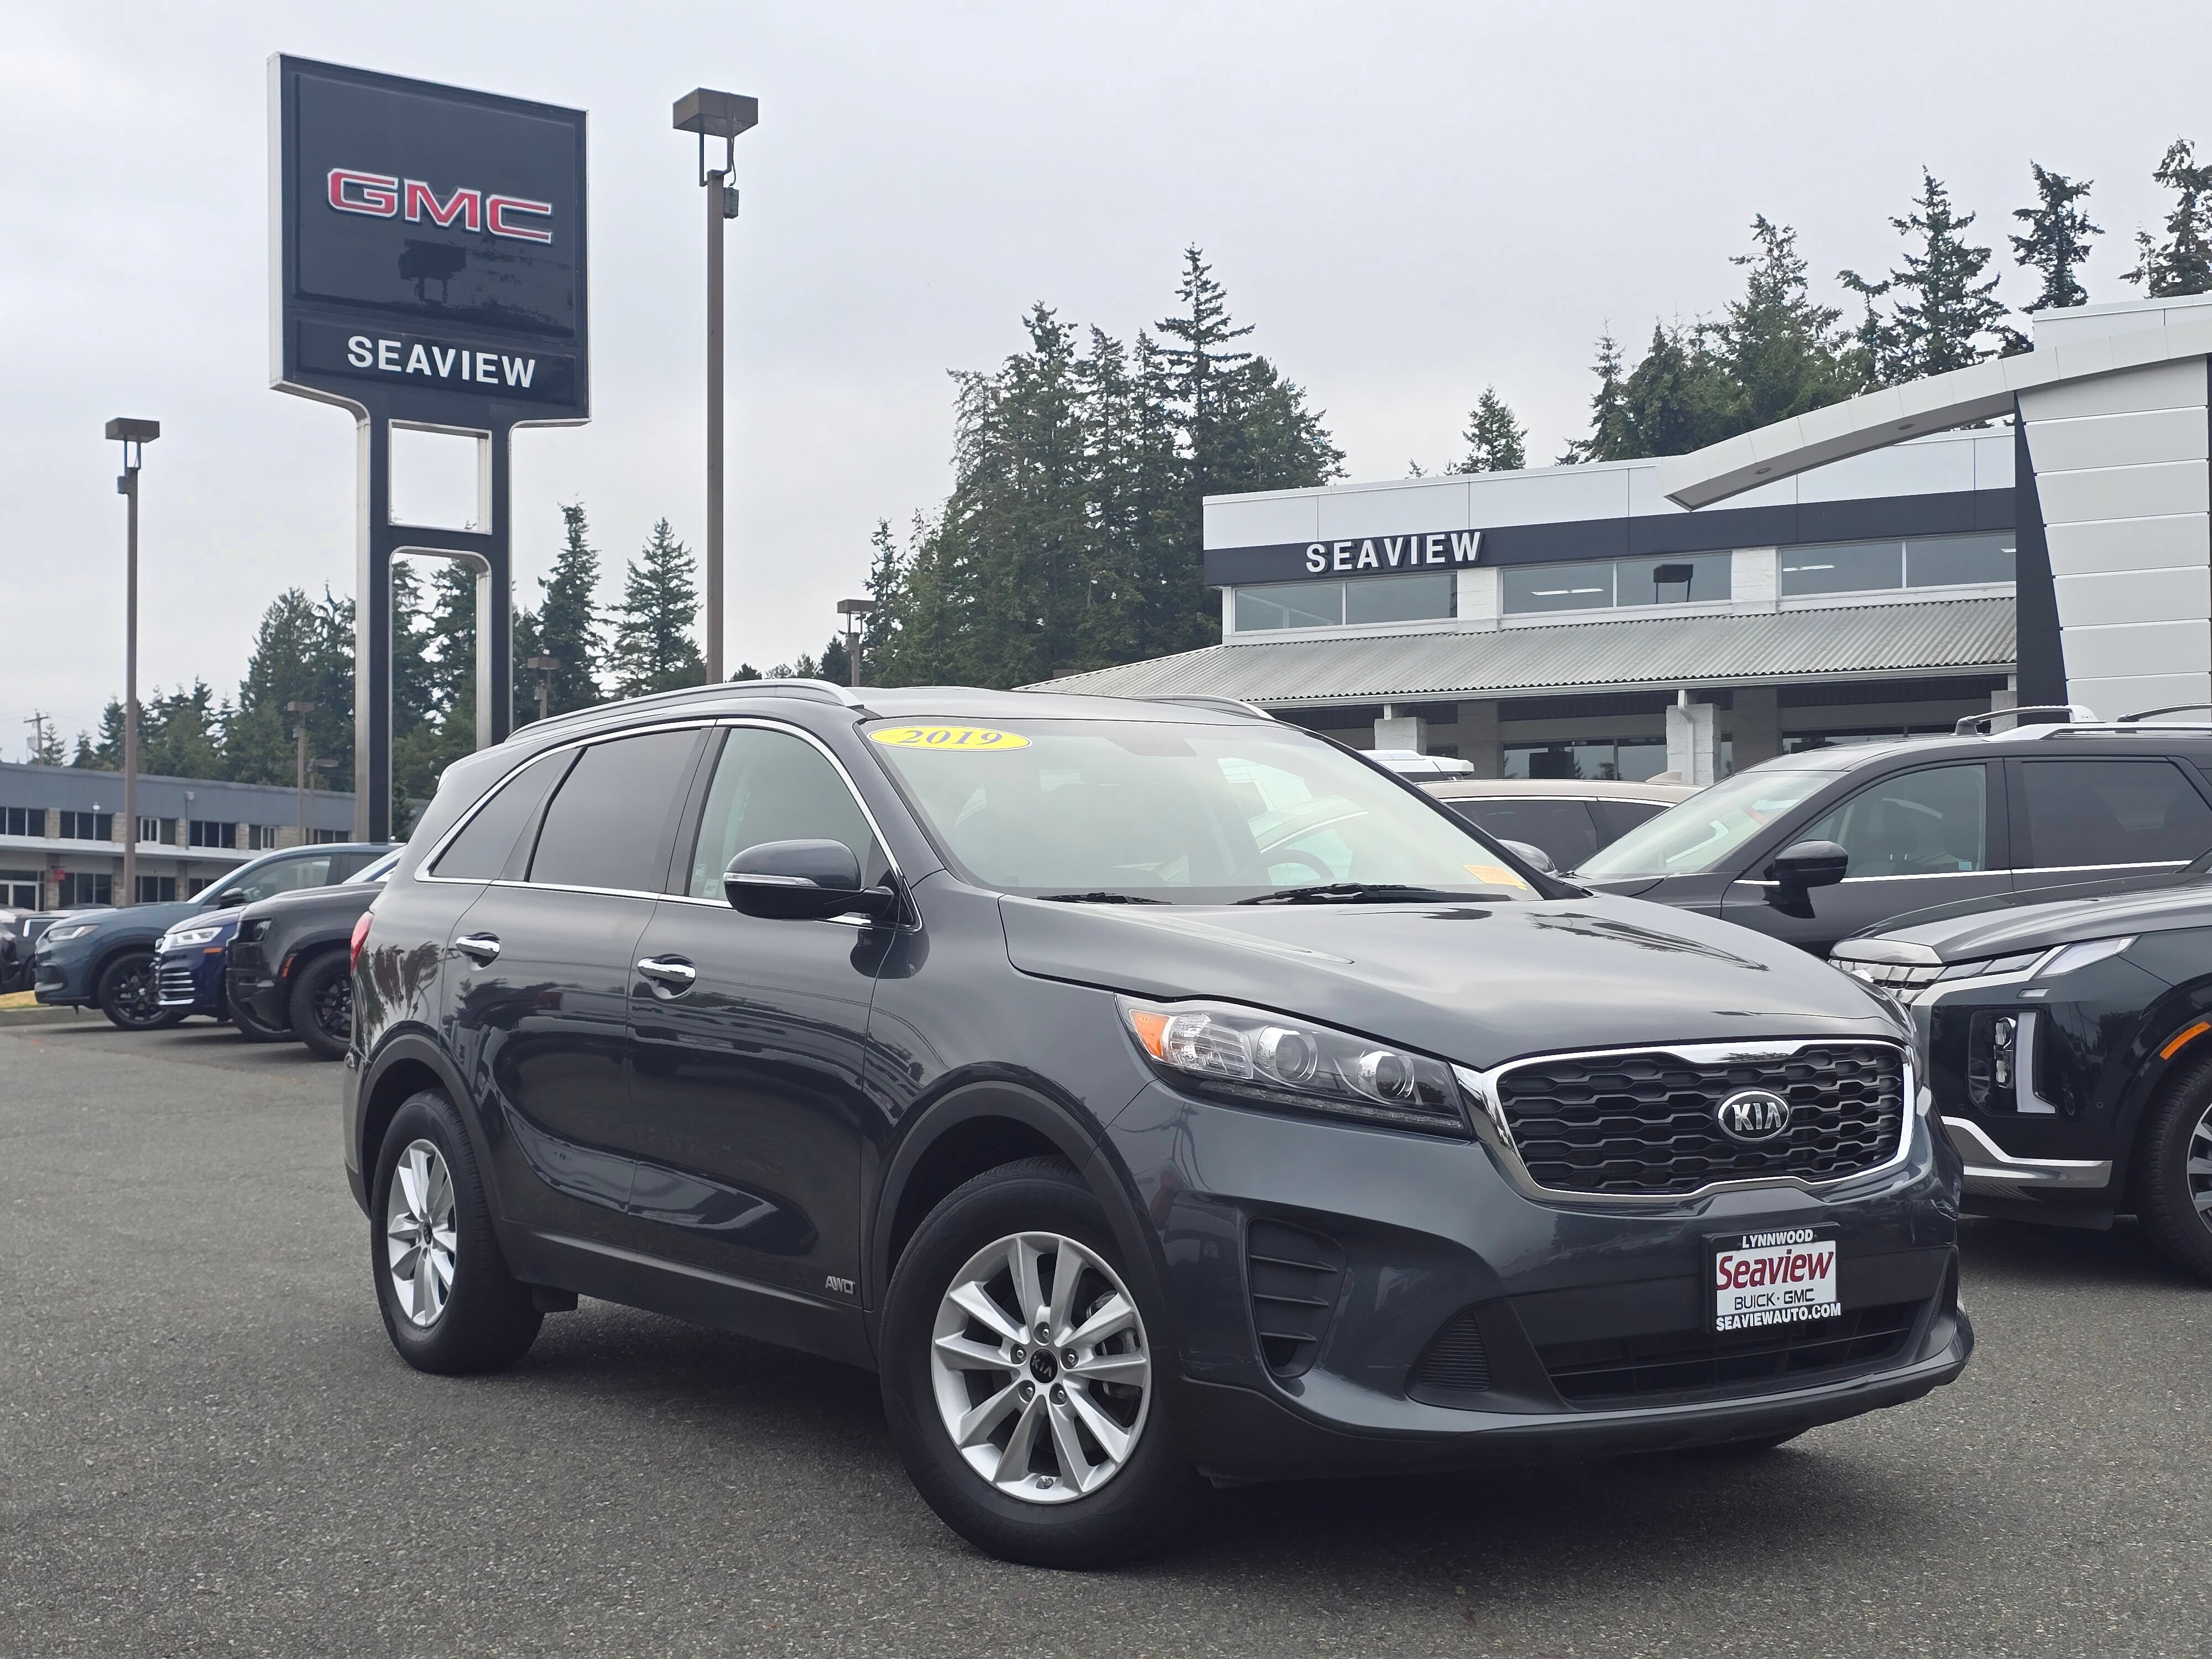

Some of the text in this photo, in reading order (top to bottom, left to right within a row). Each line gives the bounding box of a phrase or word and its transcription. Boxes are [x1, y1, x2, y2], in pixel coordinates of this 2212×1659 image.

[327, 168, 552, 244] GMC
[347, 335, 536, 388] SEAVIEW
[1306, 531, 1483, 573] SEAVIEW
[897, 729, 1003, 745] 2019
[1731, 1102, 1782, 1131] KIA
[1741, 1229, 1814, 1249] LYNNWOOD
[1716, 1248, 1835, 1291] Seaview
[1734, 1288, 1815, 1311] BUICK GMC
[1716, 1302, 1841, 1332] SEAVIEWAUTO.COM
